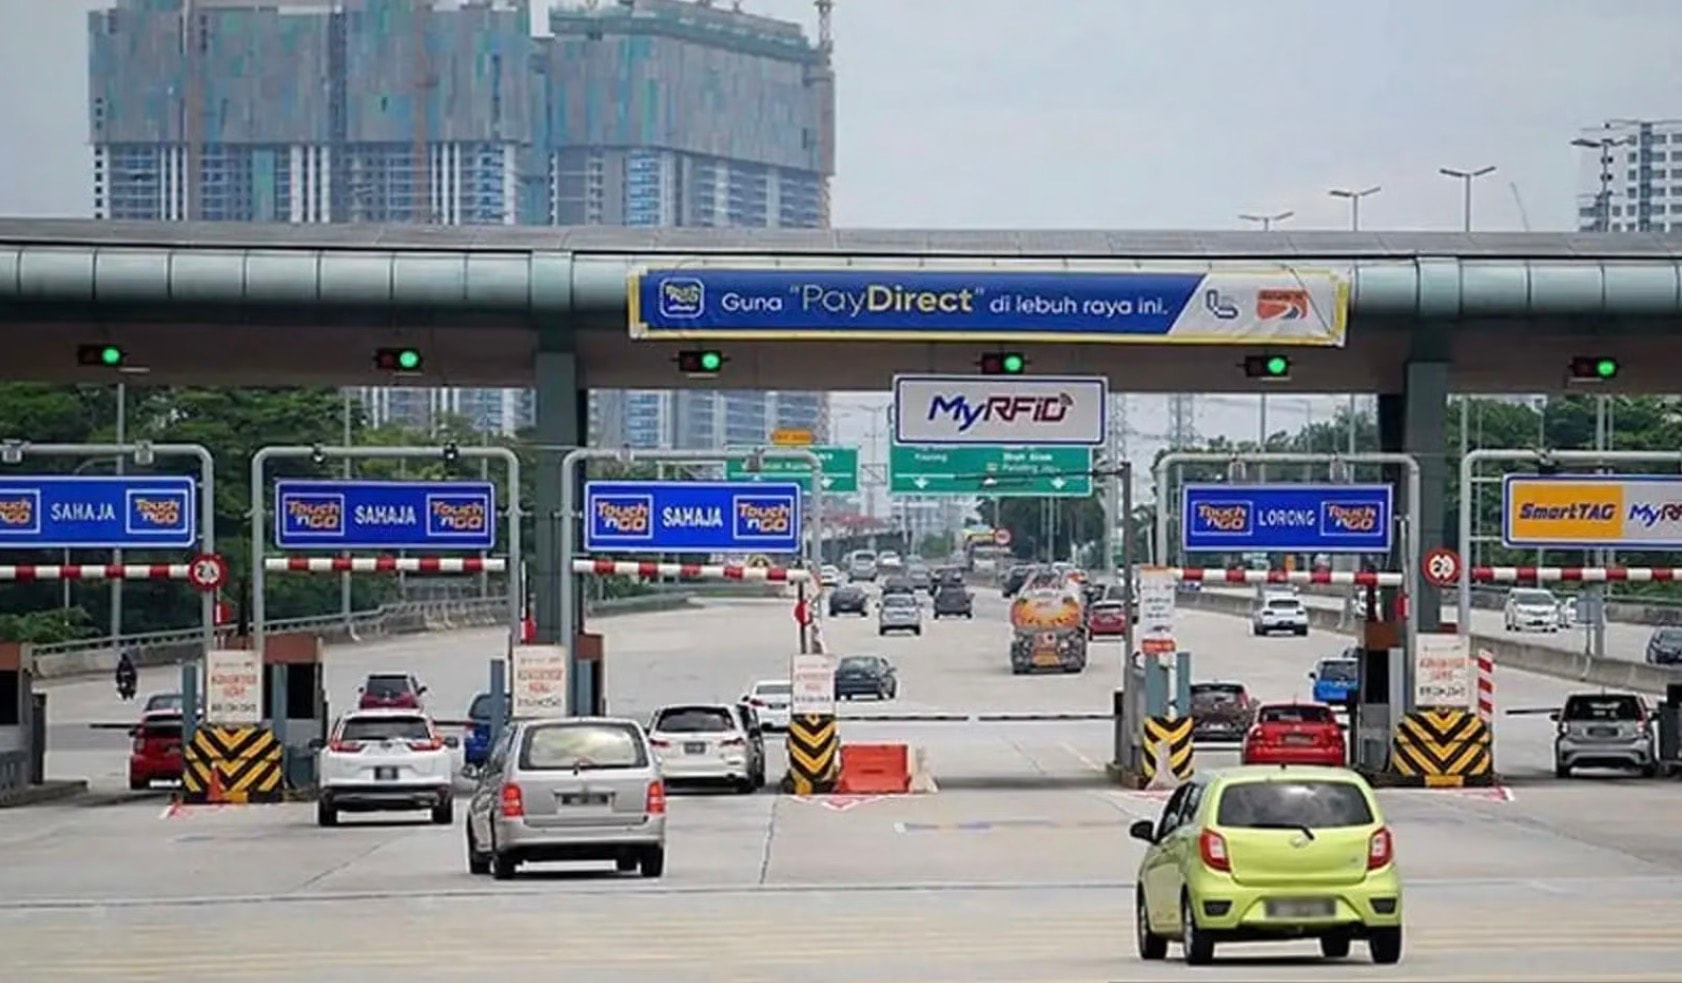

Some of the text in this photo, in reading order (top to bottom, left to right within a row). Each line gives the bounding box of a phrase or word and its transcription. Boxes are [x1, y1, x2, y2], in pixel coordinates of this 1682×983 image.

[722, 284, 1169, 319] Guna "PayDirect" di lebuh raya ini.
[50, 502, 116, 521] SAHAJA
[286, 501, 341, 516] Touch
[354, 504, 416, 525] SAHAJA
[432, 501, 484, 516] Touch
[597, 501, 648, 518] Touch
[662, 506, 724, 527] SAHAJA
[738, 503, 790, 518] Touch
[1258, 509, 1316, 527] LORONG
[1518, 502, 1617, 521] SmartTAG
[1628, 504, 1682, 528] MyR
